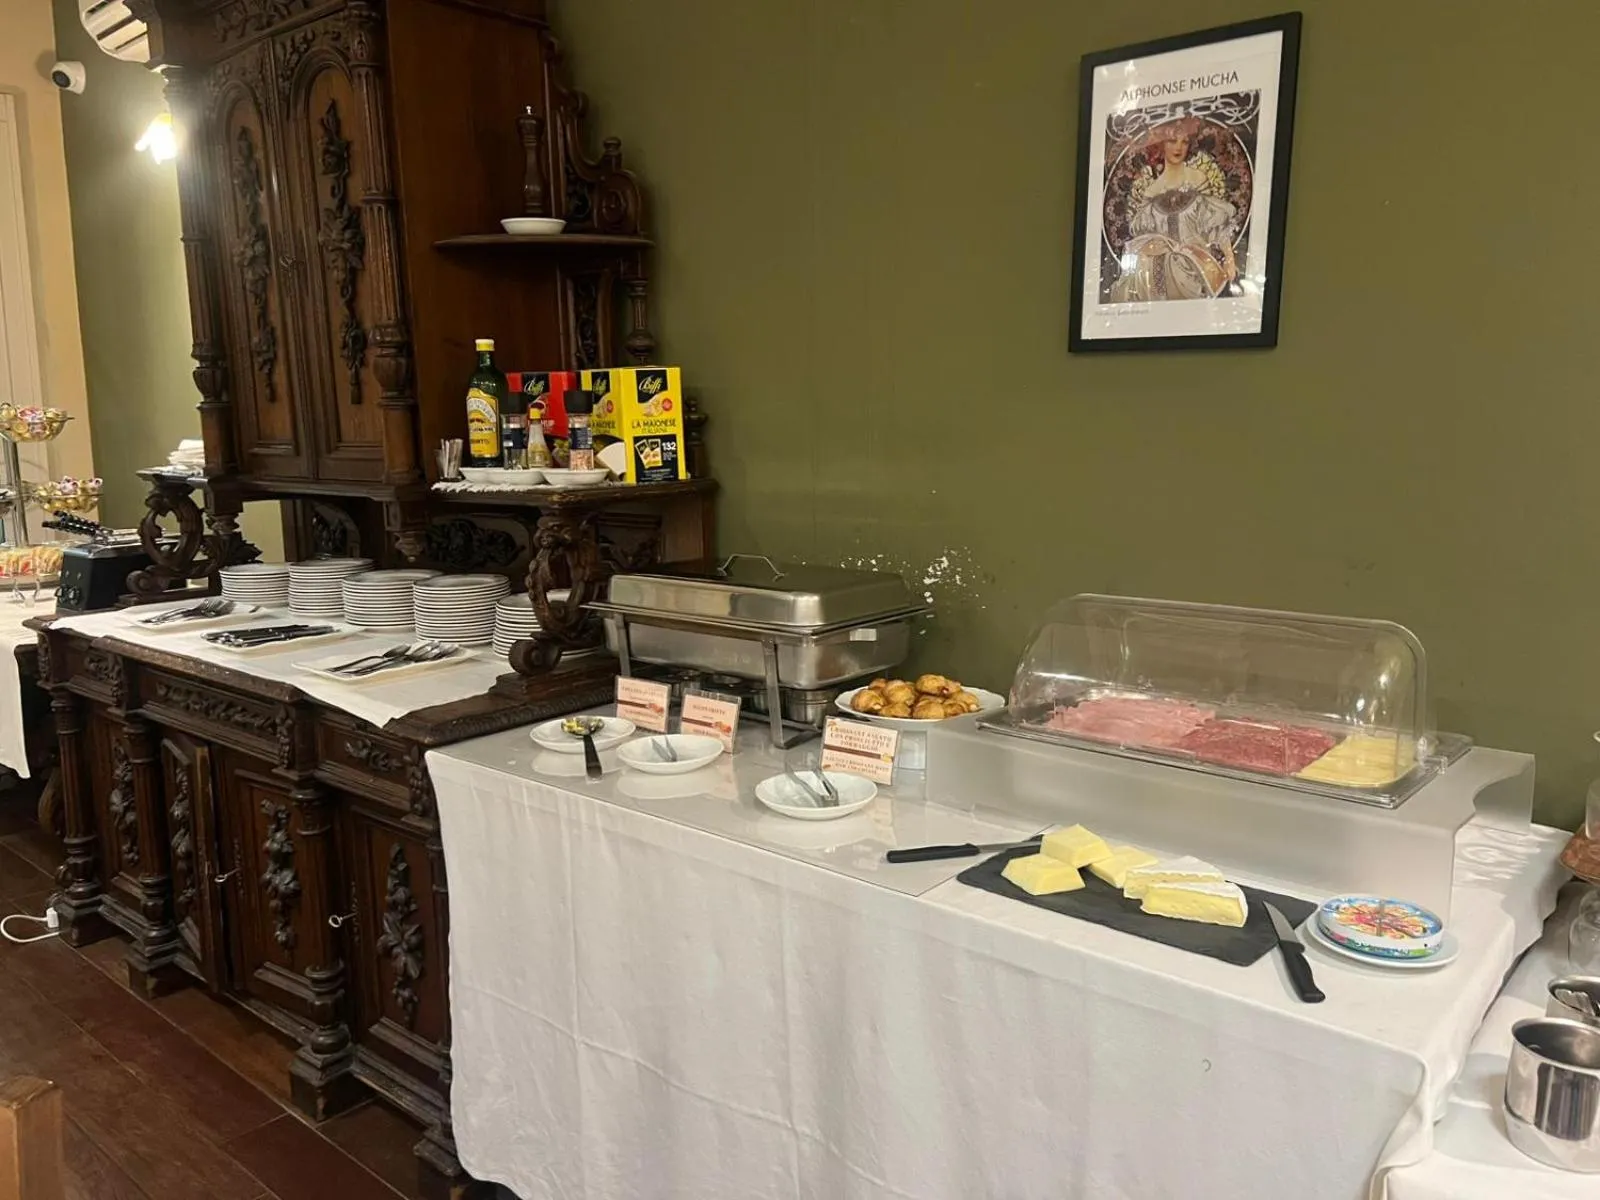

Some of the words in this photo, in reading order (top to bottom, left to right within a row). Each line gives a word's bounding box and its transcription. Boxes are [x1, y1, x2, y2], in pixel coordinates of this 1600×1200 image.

[1121, 80, 1186, 101] ALPHONSE
[1190, 70, 1239, 90] MUCHA
[632, 421, 641, 429] LA
[643, 418, 676, 428] MAIONESE
[662, 442, 677, 451] 132
